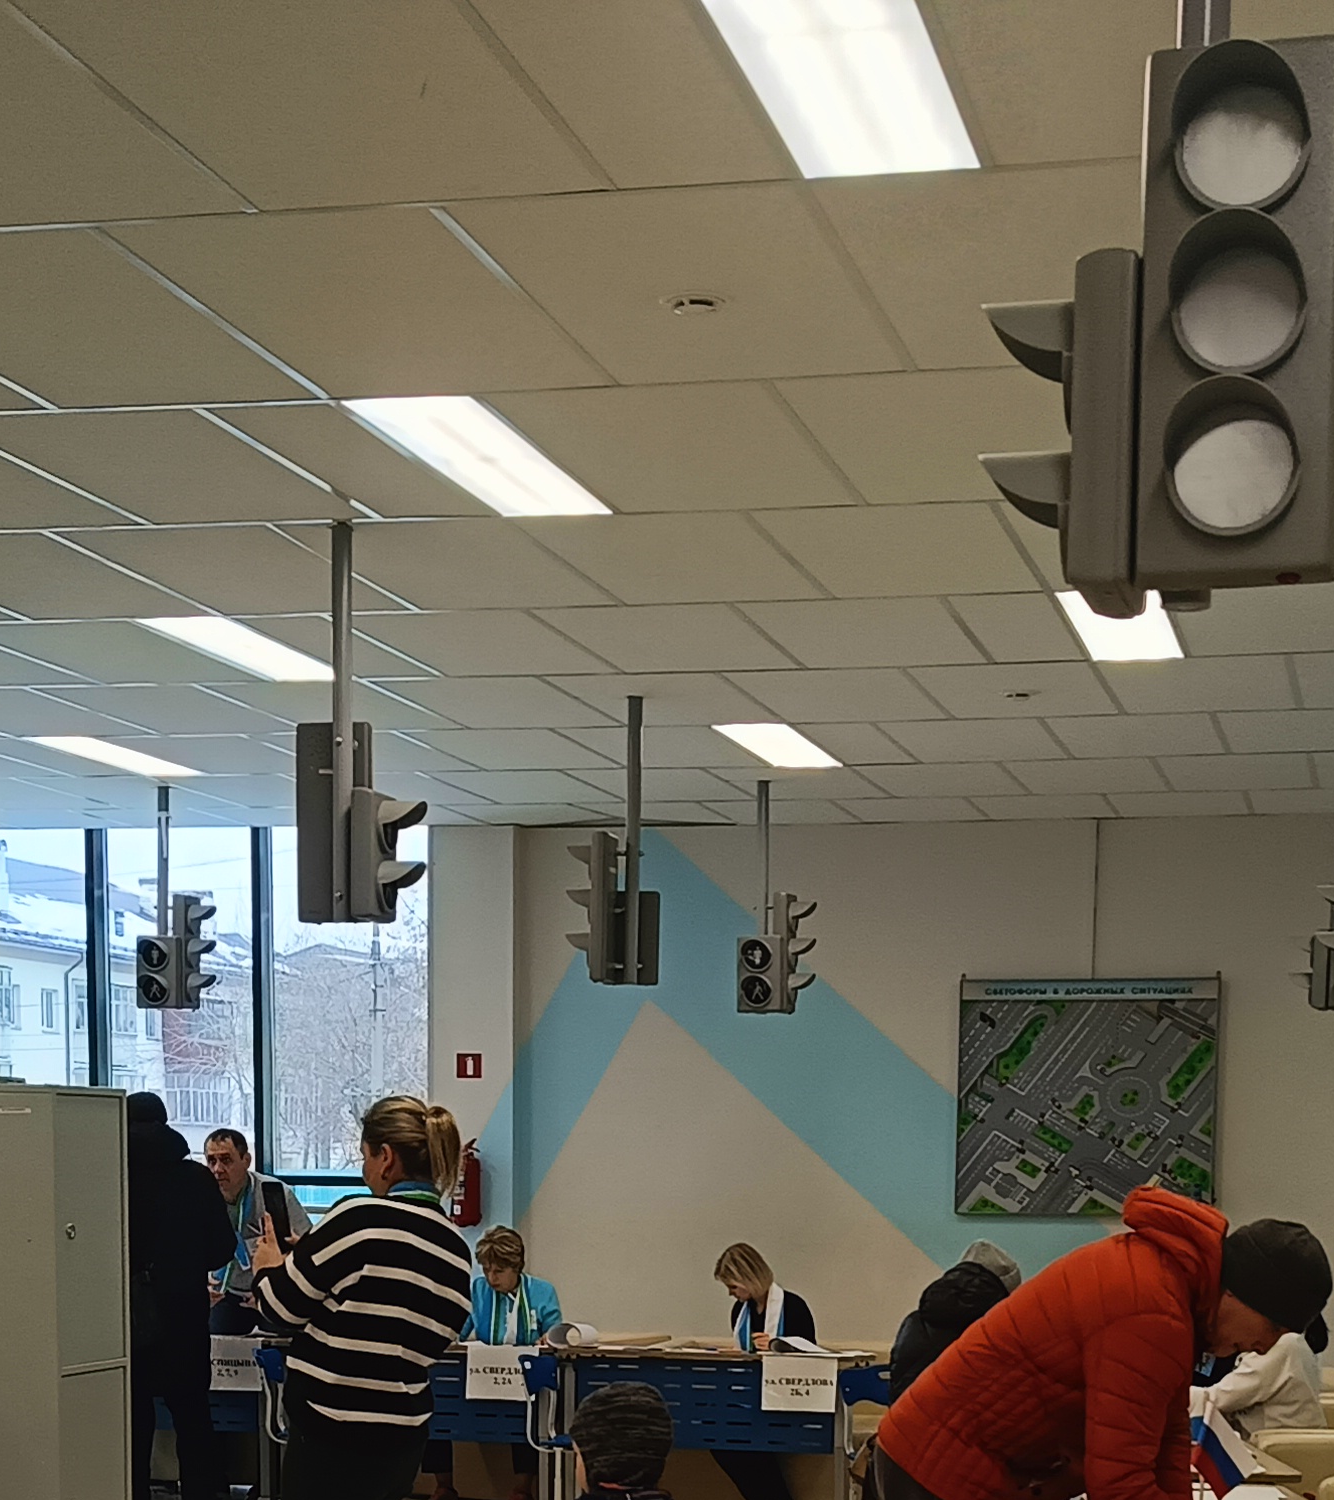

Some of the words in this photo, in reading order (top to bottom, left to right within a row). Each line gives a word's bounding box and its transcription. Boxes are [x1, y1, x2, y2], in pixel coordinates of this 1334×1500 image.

[985, 987, 1047, 996] СВЕТОФОРЫ
[1064, 987, 1126, 996] ДОРОЖНЫХ
[1131, 986, 1193, 995] СИТУАЦИЯХ
[482, 1366, 524, 1375] СВЕРДЛО
[778, 1377, 834, 1386] СВЕРДЛОВА
